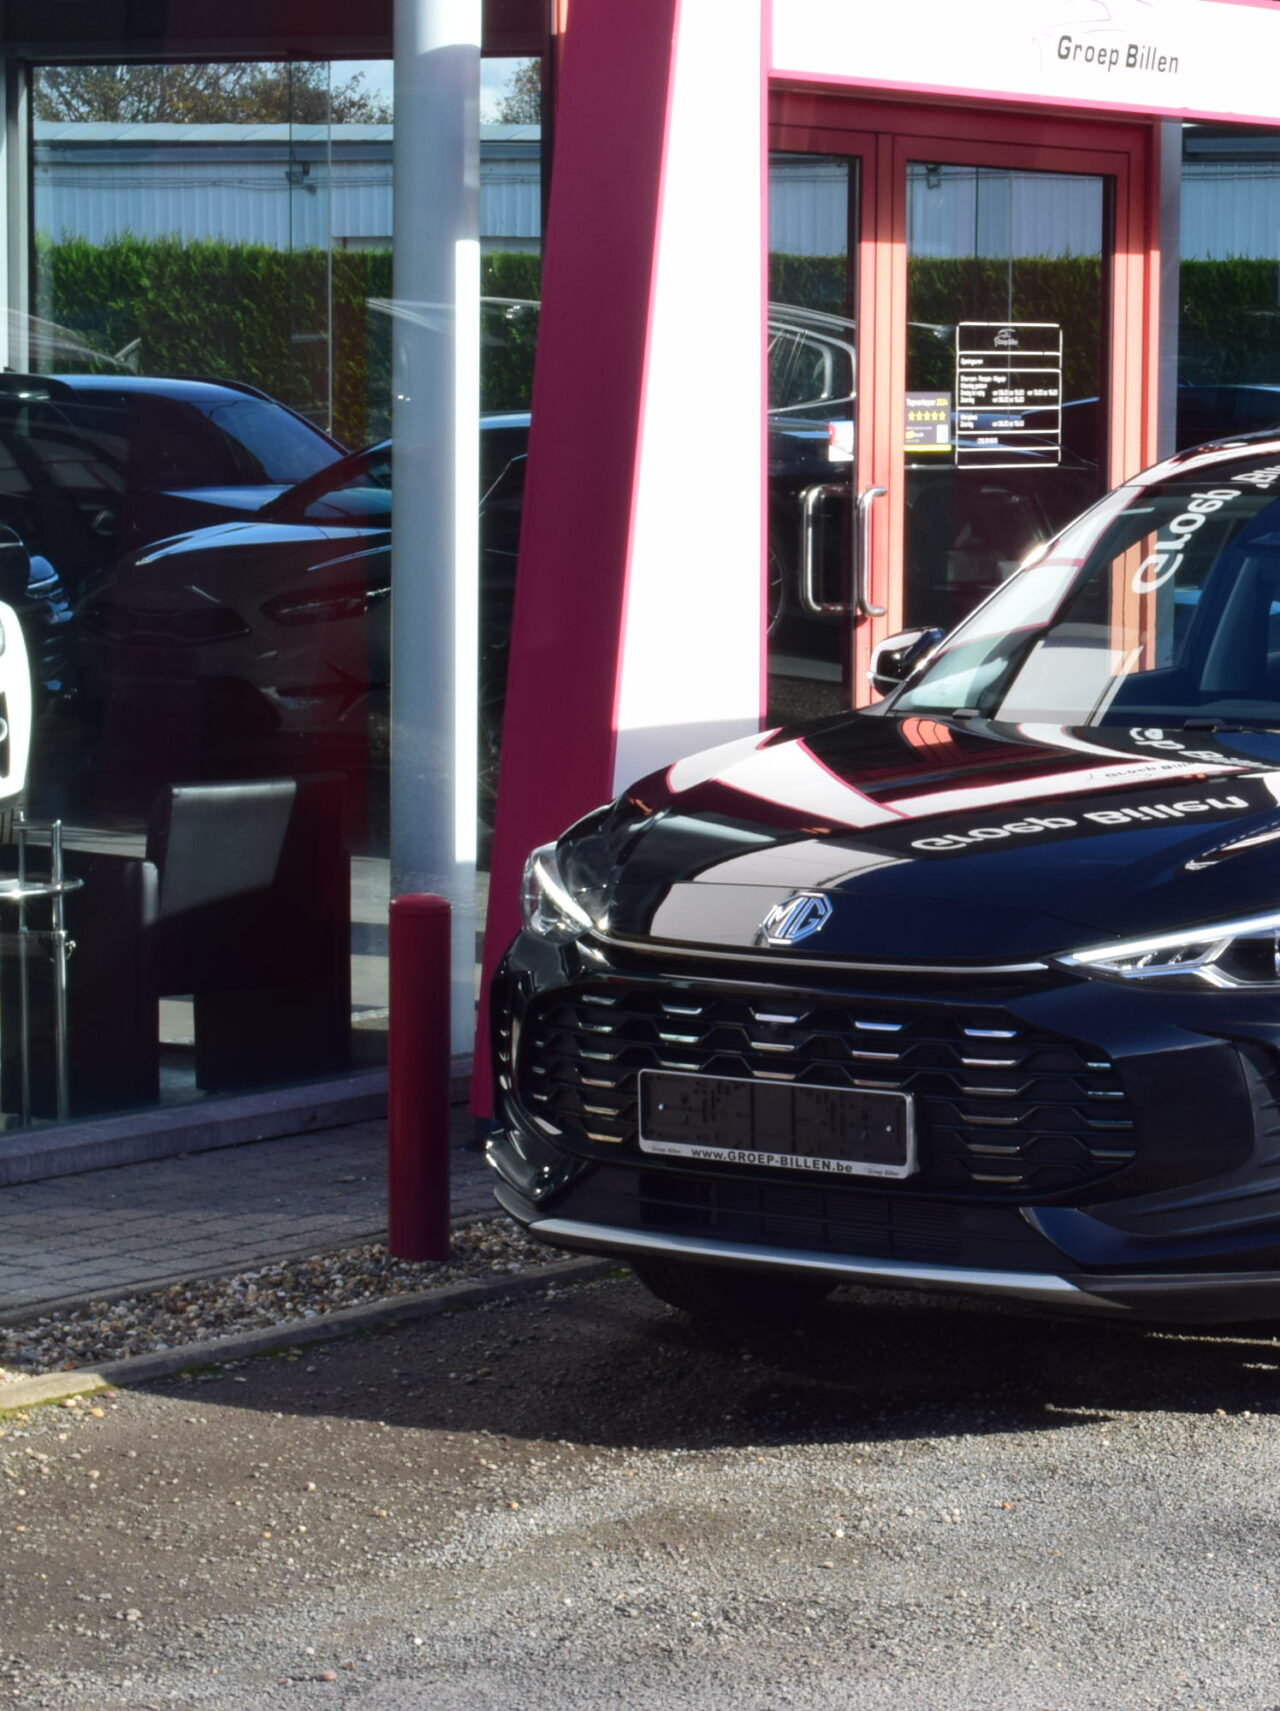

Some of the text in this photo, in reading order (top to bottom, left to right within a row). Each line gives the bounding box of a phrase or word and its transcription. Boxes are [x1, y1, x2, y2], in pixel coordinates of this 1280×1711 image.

[1057, 35, 1179, 73] Groep Billen
[762, 892, 833, 944] MG
[691, 1148, 853, 1173] www.GROEP-BILLEN.be
